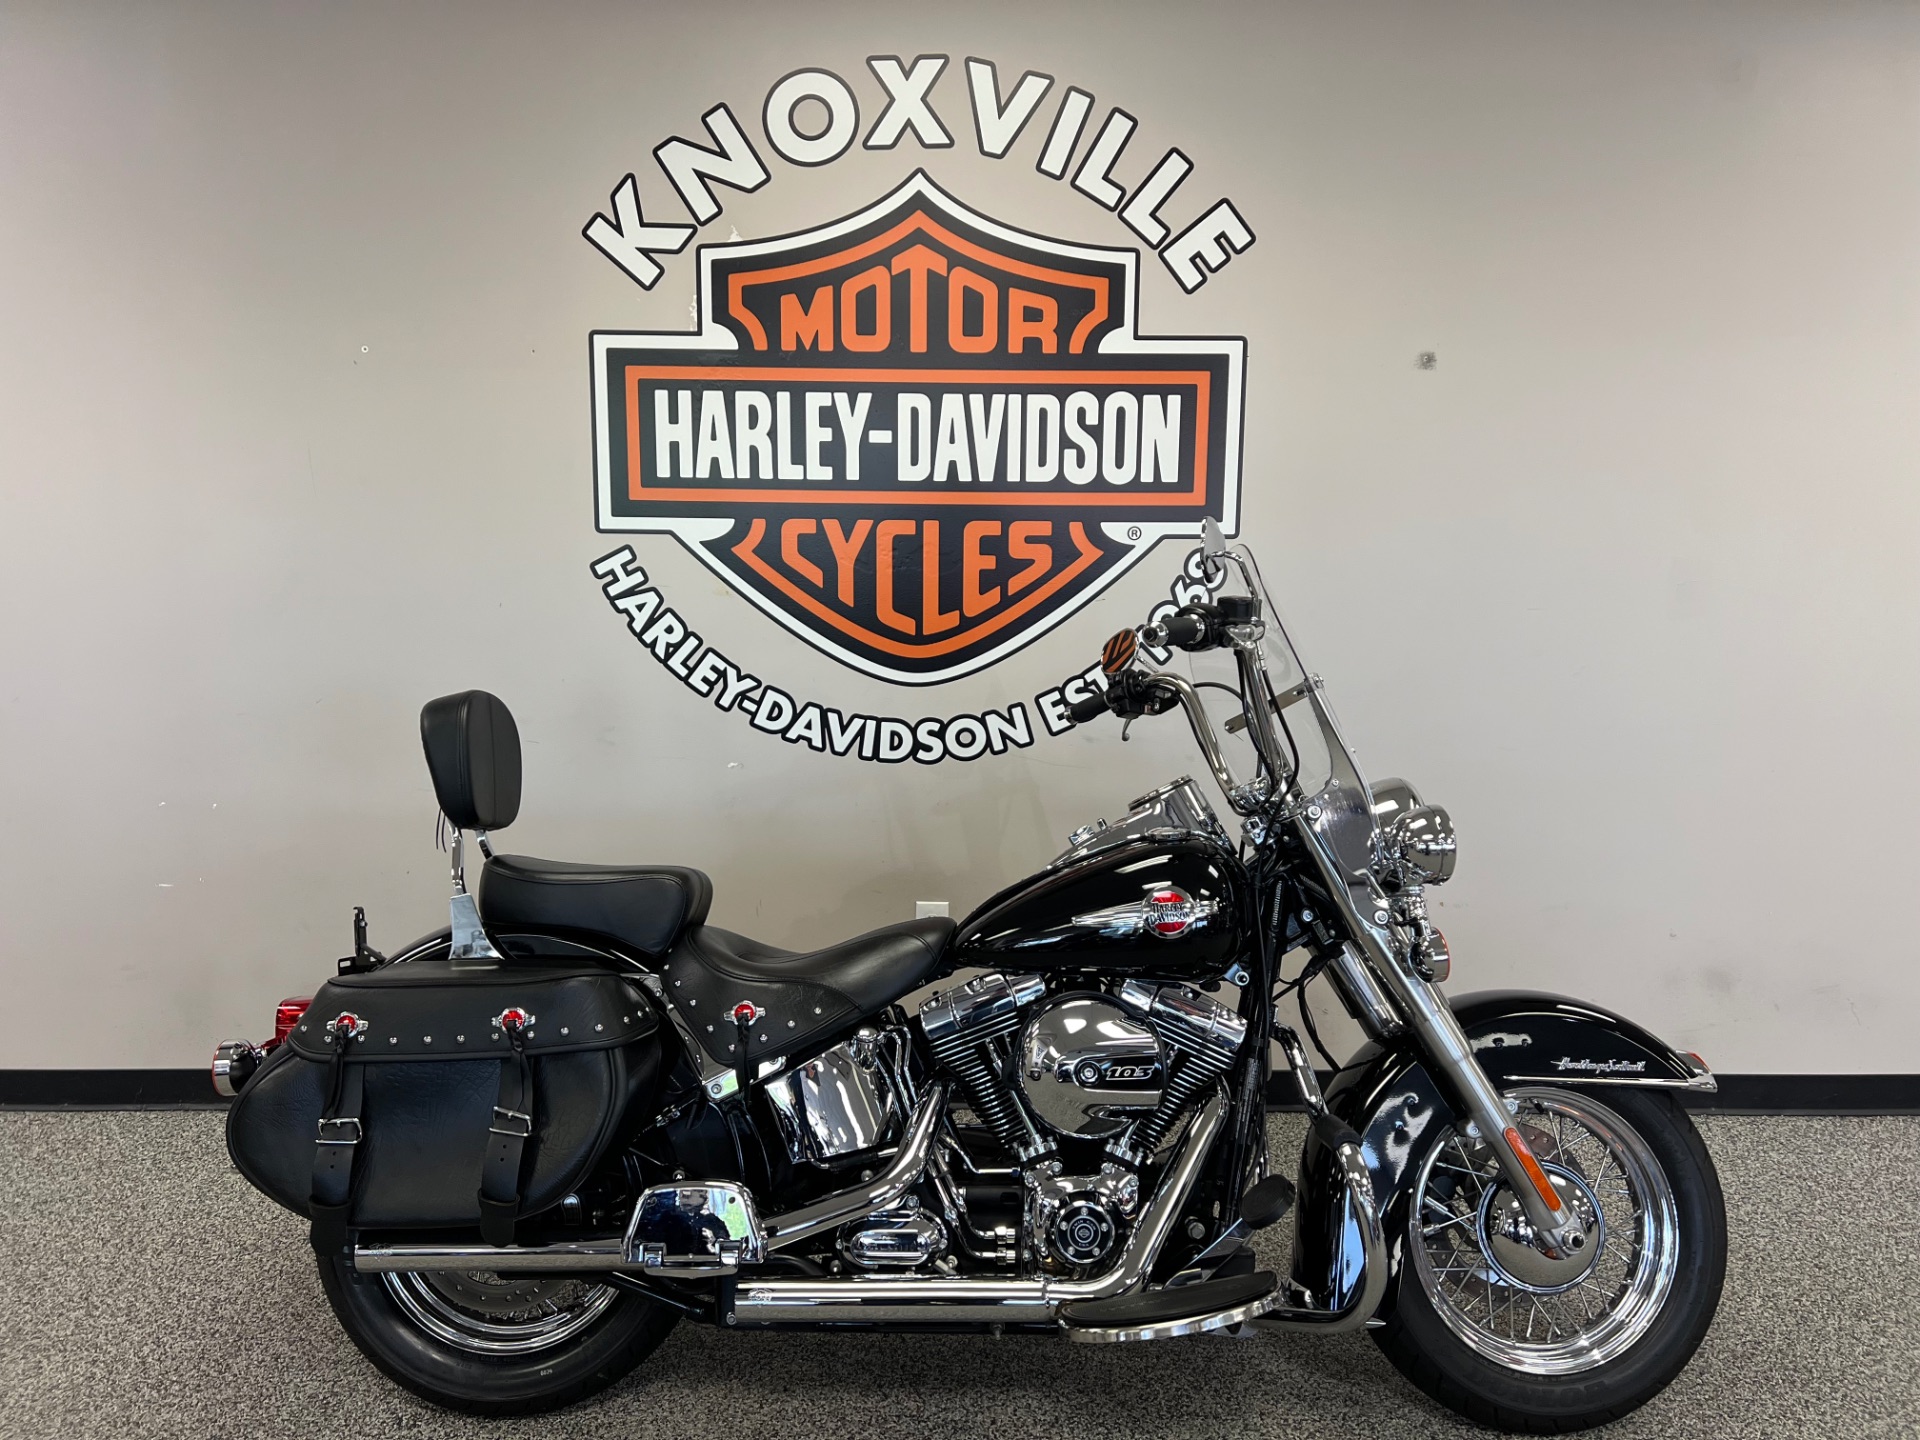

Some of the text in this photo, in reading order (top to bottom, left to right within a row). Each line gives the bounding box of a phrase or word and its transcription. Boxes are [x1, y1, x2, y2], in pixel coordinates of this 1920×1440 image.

[582, 54, 1256, 294] KNOXVILLE
[780, 243, 1058, 354] MOTOR
[654, 389, 1182, 485] HARLEY-DAVIDSON
[780, 519, 1052, 636] CYCLES
[590, 544, 1034, 765] HARLEY-DAVIDSON
[1106, 1065, 1155, 1080] 103
